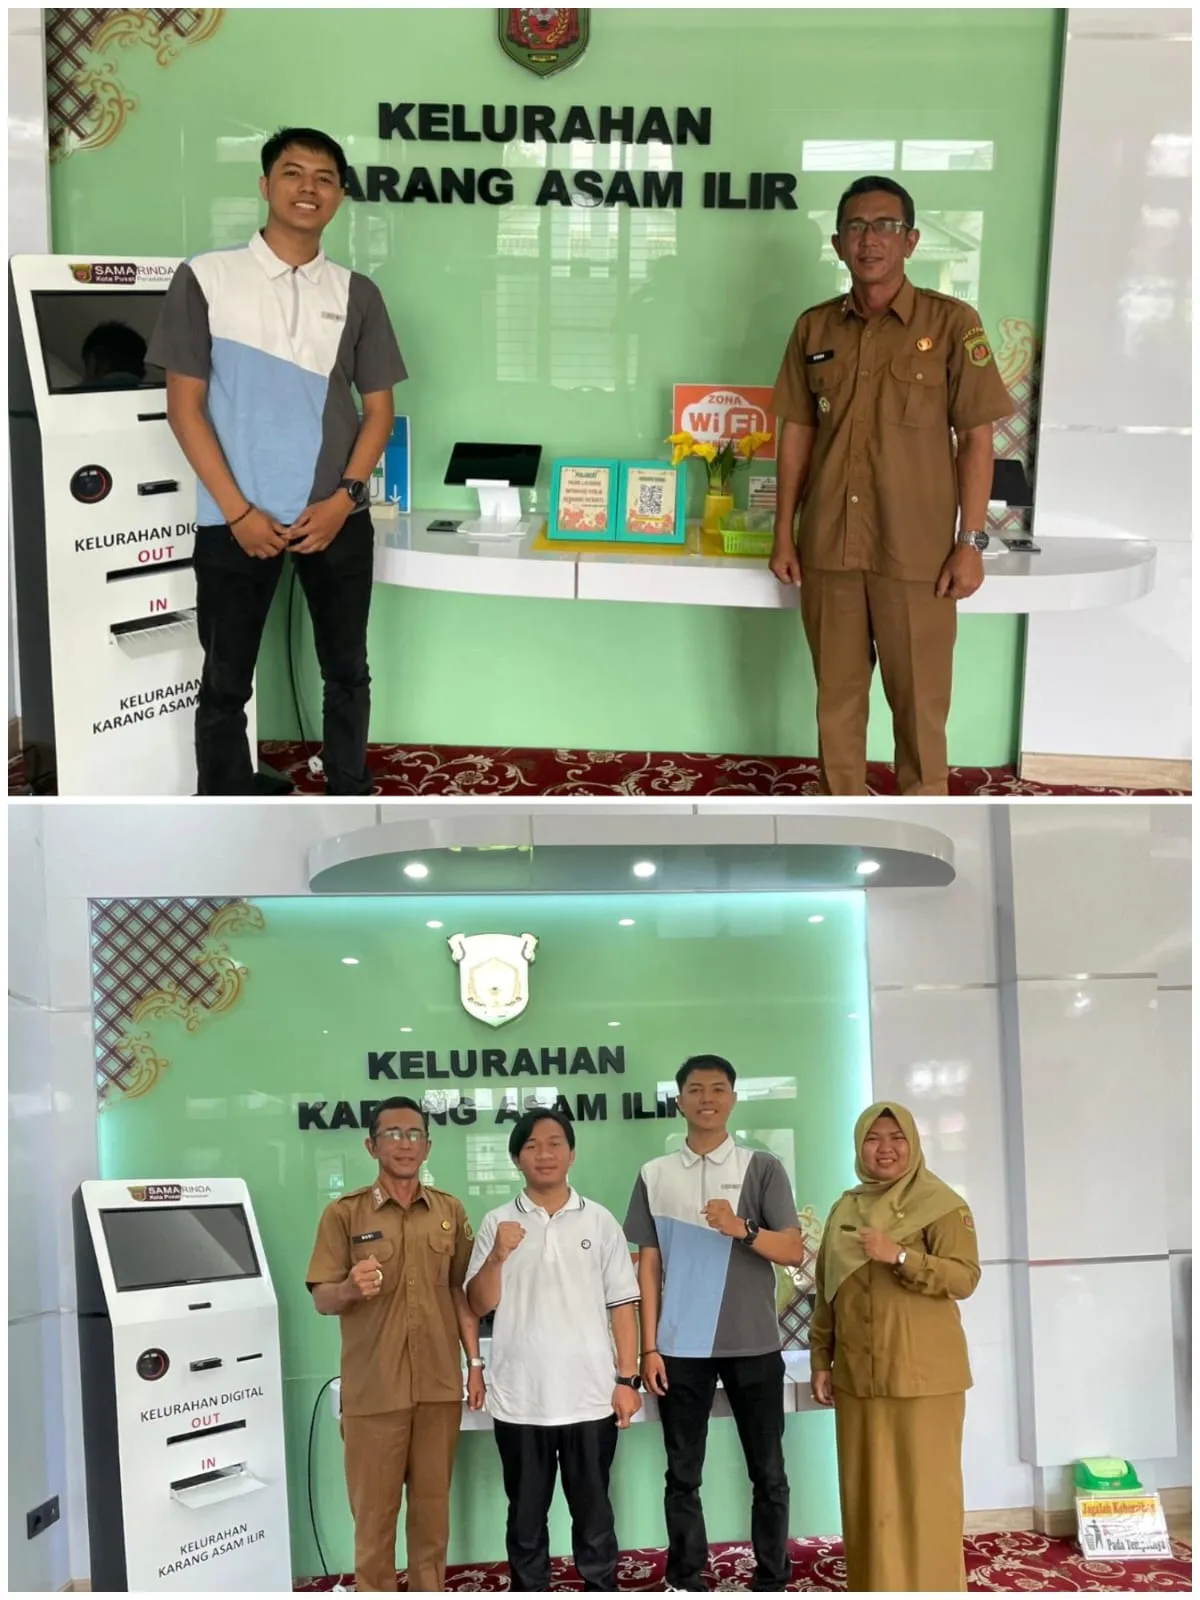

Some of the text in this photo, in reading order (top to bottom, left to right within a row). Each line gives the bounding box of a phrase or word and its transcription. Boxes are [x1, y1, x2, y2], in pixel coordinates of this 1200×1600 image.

[378, 102, 712, 145] KELURAHAN
[344, 165, 798, 210] ARANG ASAM ILIR
[707, 395, 742, 405] ZONA
[75, 525, 172, 552] KELURAHAN
[138, 546, 175, 563] OUT
[149, 598, 168, 612] IN
[120, 678, 202, 711] KELURAHAN
[92, 694, 200, 735] KARANG ASAM
[367, 1045, 626, 1080] KELURAHAN
[297, 1096, 477, 1130] KANG
[140, 1386, 264, 1423] KELURAHAN DIGITAL
[191, 1412, 220, 1429] OUT
[201, 1457, 216, 1470] IN
[158, 1529, 265, 1578] KARANG ASAM ILIR
[180, 1523, 248, 1556] KELURAHAN
[1106, 1538, 1125, 1550] Pada
